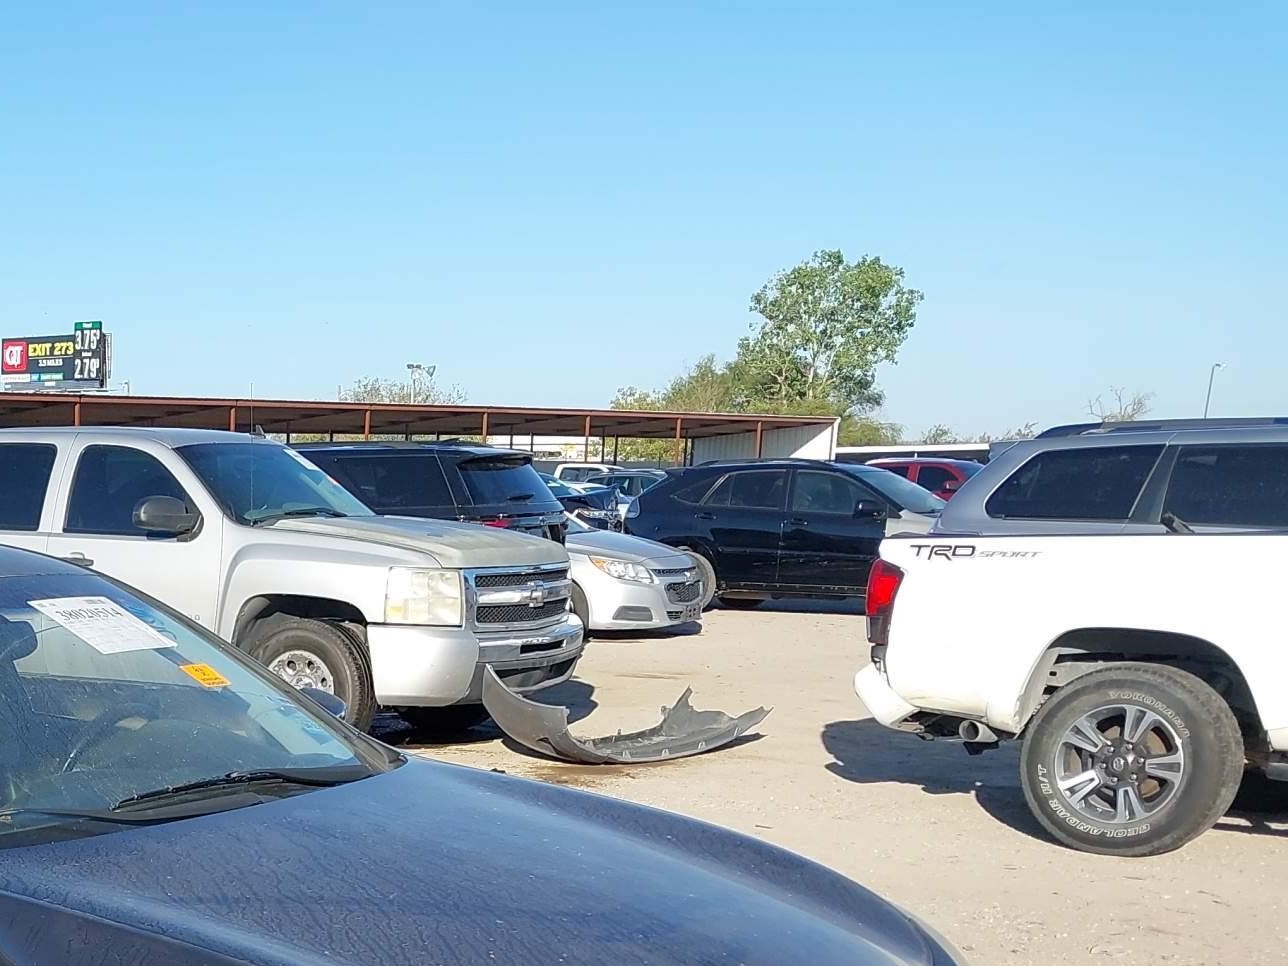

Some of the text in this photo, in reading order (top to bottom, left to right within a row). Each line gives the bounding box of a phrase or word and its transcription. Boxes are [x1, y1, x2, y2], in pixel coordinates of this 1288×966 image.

[28, 341, 74, 357] EXIT 273
[910, 545, 976, 560] TRD
[55, 607, 124, 621] 38020514
[1109, 691, 1191, 737] YOKOHAMA
[1048, 798, 1151, 838] GEOLANDAR
